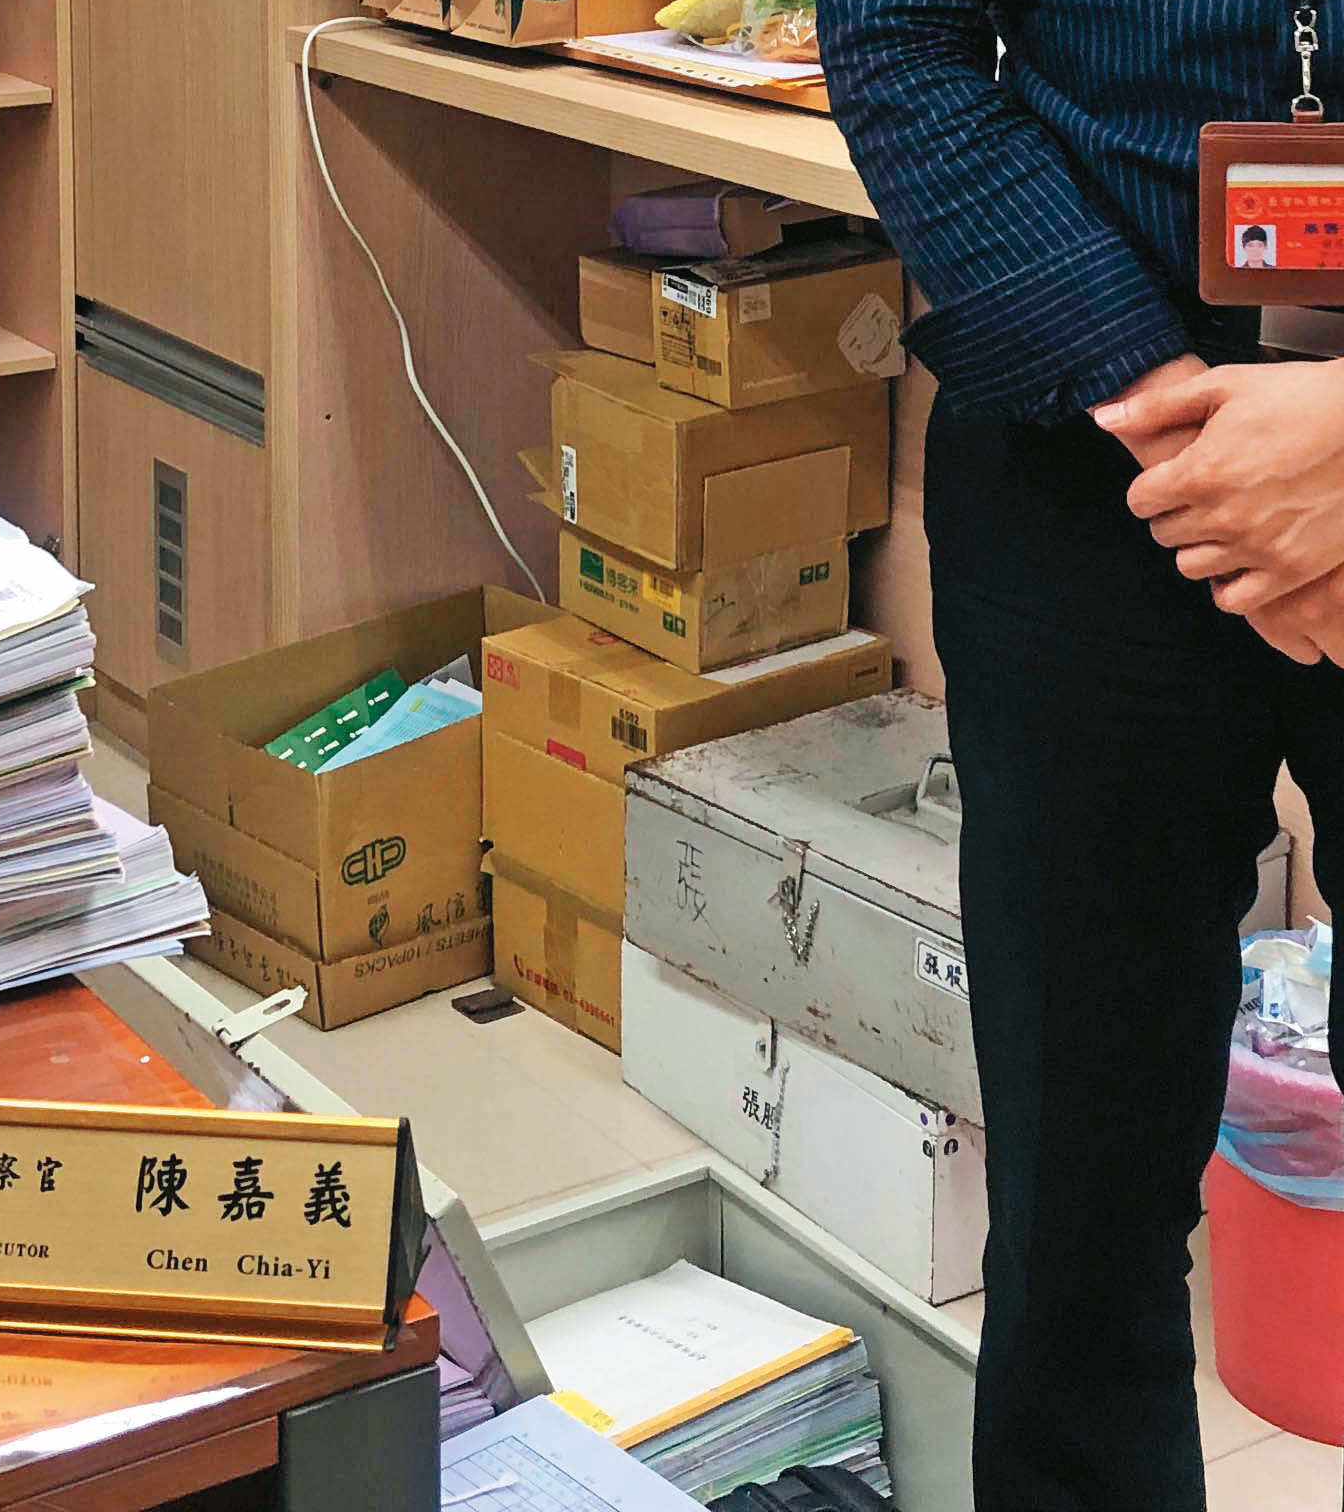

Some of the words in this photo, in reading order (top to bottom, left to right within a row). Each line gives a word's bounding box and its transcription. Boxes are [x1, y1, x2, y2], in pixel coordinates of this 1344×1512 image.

[135, 1154, 353, 1229] 陳嘉義
[146, 1249, 209, 1274] Chen
[236, 1253, 332, 1281] Chia-Yi
